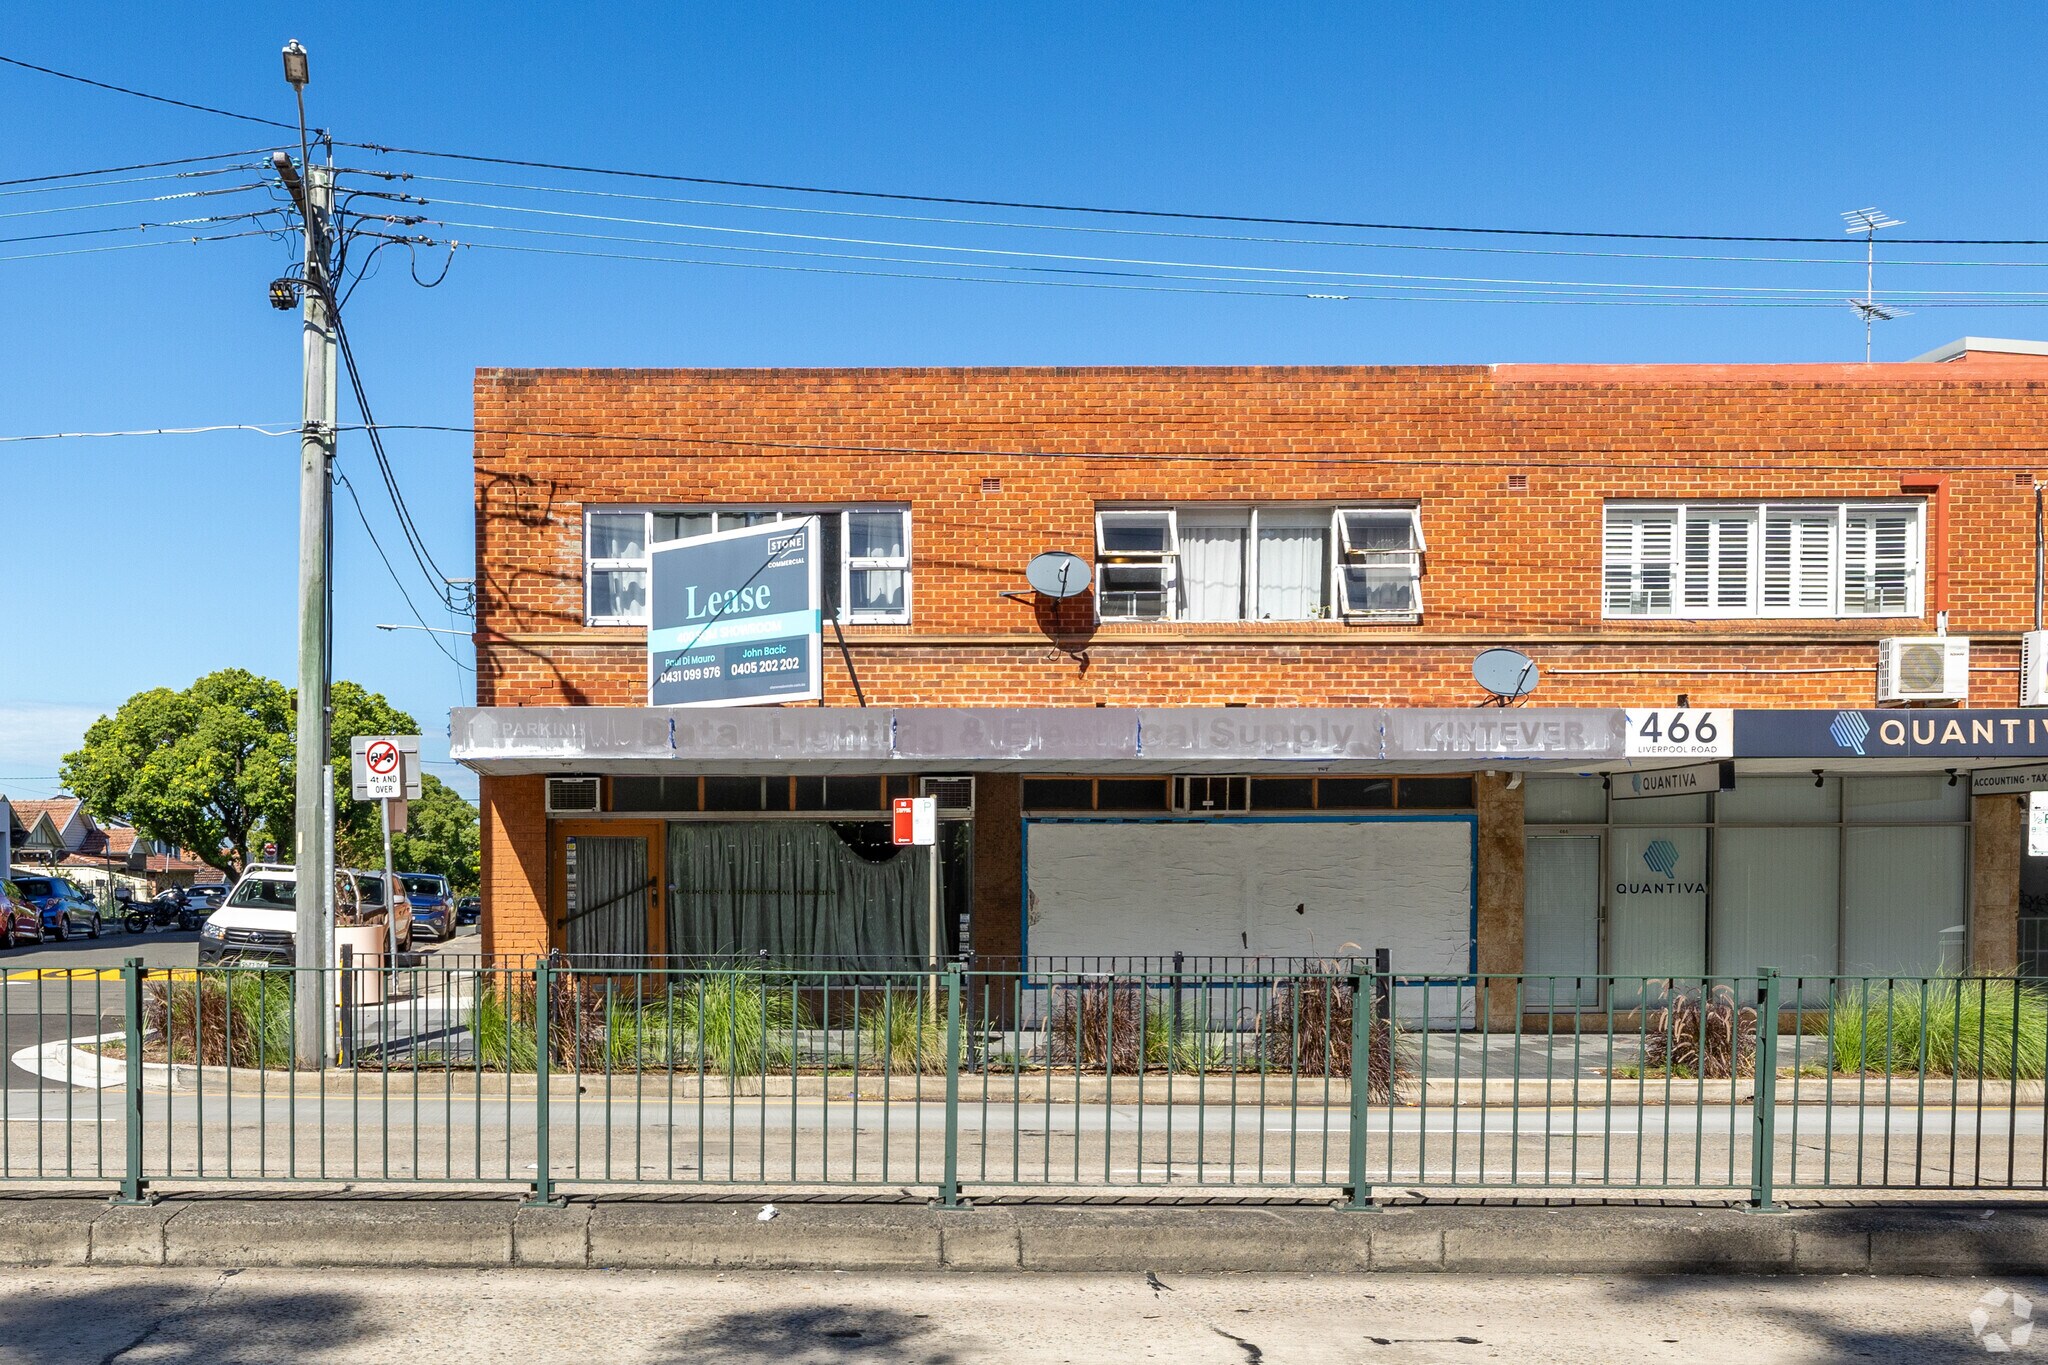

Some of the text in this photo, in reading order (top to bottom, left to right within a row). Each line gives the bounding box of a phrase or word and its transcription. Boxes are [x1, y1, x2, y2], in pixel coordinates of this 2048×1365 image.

[771, 537, 802, 551] STONE
[767, 557, 805, 569] COMMERCIAL
[685, 584, 771, 620] Lease
[742, 644, 787, 659] John Bacic
[682, 656, 691, 665] Di
[691, 654, 716, 664] Mauro
[731, 657, 800, 676] 0405 202 202
[660, 665, 721, 684] 0431 099 976
[1639, 711, 1718, 744] 466
[1209, 717, 1354, 754] Supply
[1638, 745, 1718, 754] LIVERPOOL ROAD
[382, 775, 397, 783] AND
[1642, 773, 1697, 791] QUANTIVA
[1974, 775, 2025, 787] ACCOUNTING
[375, 785, 393, 794] OVER
[1616, 882, 1706, 894] QUANTIVA
